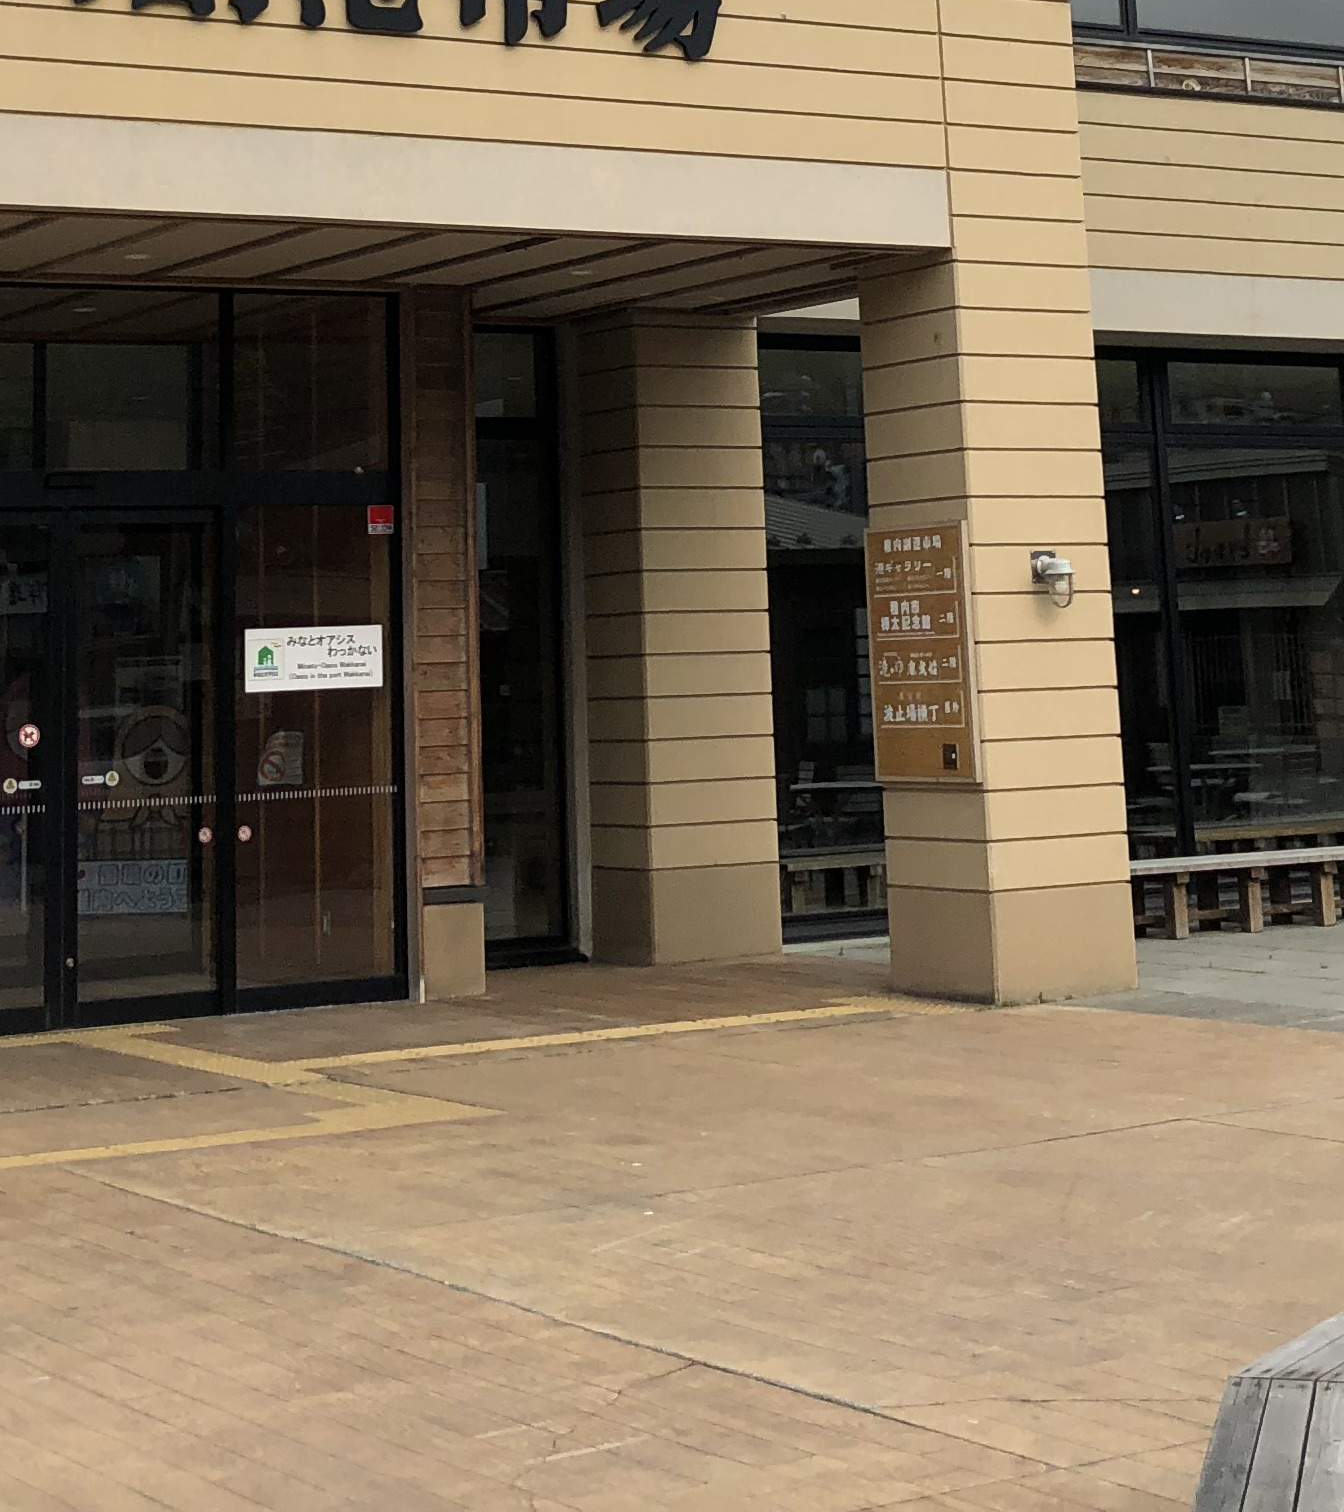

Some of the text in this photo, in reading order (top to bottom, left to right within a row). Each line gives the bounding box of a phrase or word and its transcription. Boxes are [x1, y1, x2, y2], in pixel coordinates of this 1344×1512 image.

[327, 644, 377, 658] わっかない
